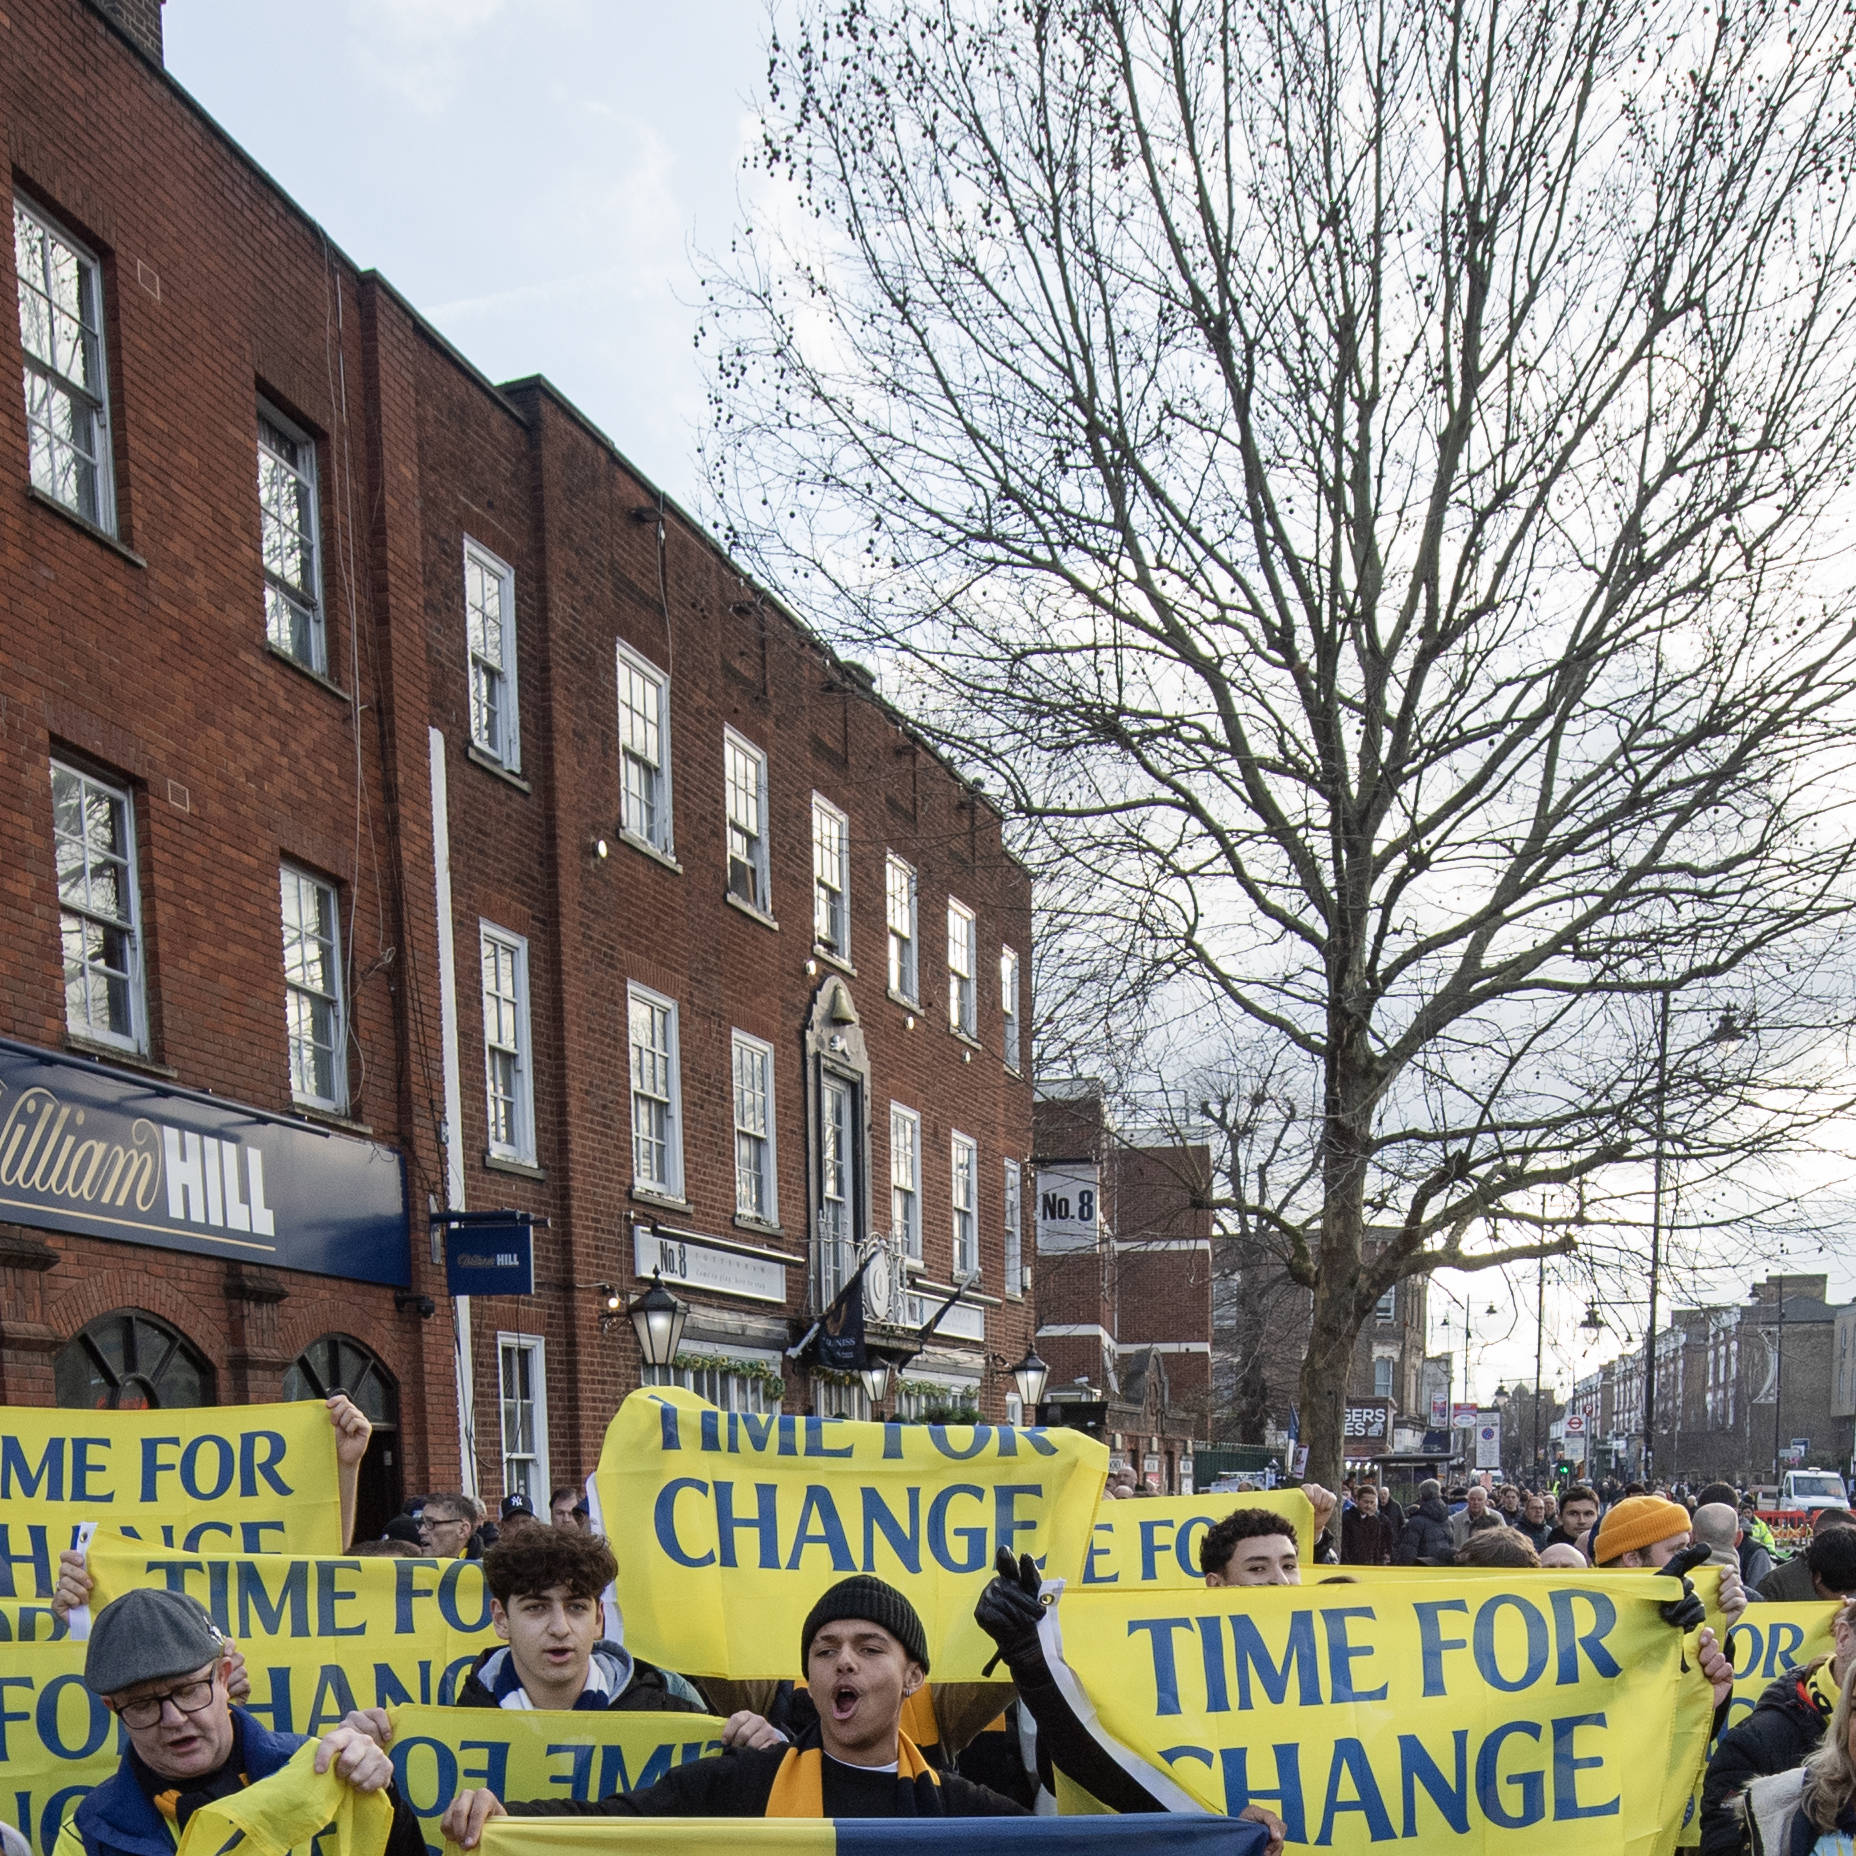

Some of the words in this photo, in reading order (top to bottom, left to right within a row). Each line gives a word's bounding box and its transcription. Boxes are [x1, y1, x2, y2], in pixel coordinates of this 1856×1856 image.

[161, 1127, 275, 1236] HILL
[496, 1253, 519, 1267] HILL
[140, 1429, 295, 1502] FOR
[654, 1476, 1047, 1576] CHANGE
[1127, 1606, 1389, 1717] TIME
[1416, 1588, 1623, 1700] FOR
